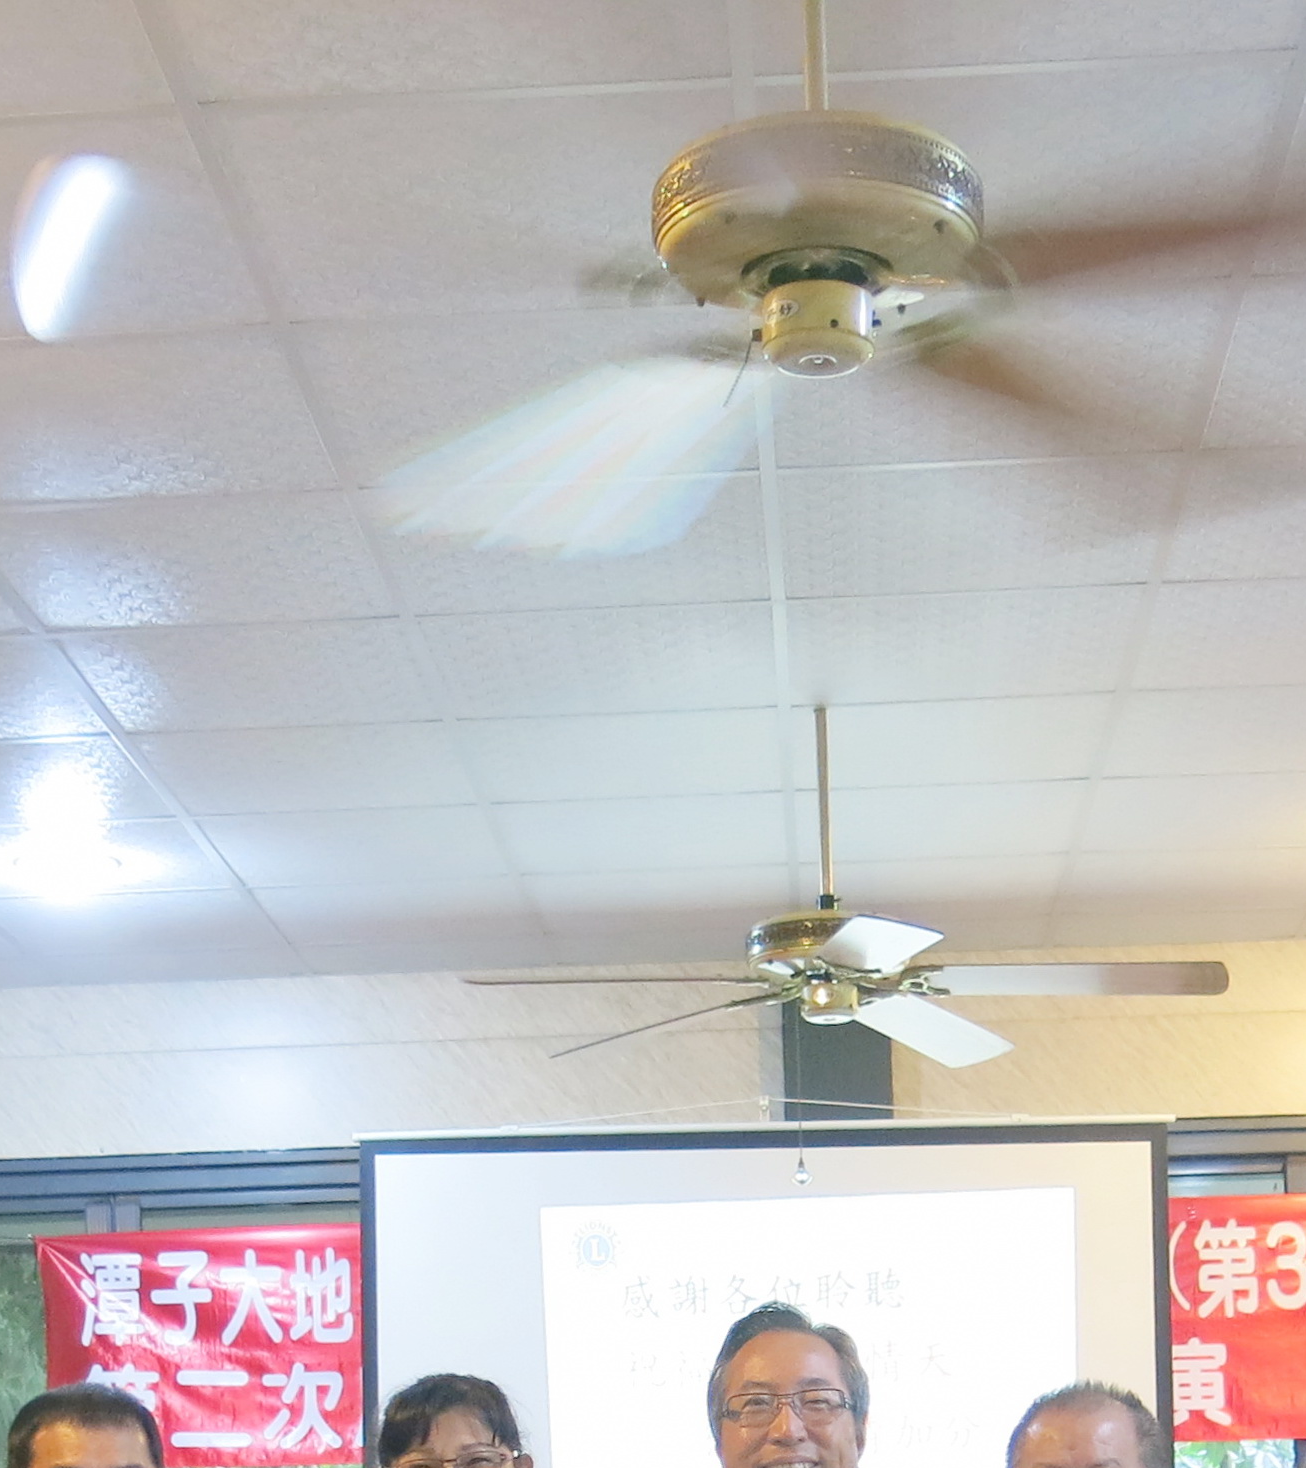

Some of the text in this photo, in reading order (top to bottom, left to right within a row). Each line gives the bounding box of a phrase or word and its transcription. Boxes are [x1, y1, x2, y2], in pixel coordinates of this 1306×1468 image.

[79, 1246, 354, 1347] 潭子大地
[622, 1266, 906, 1321] 感謝各位聆聽
